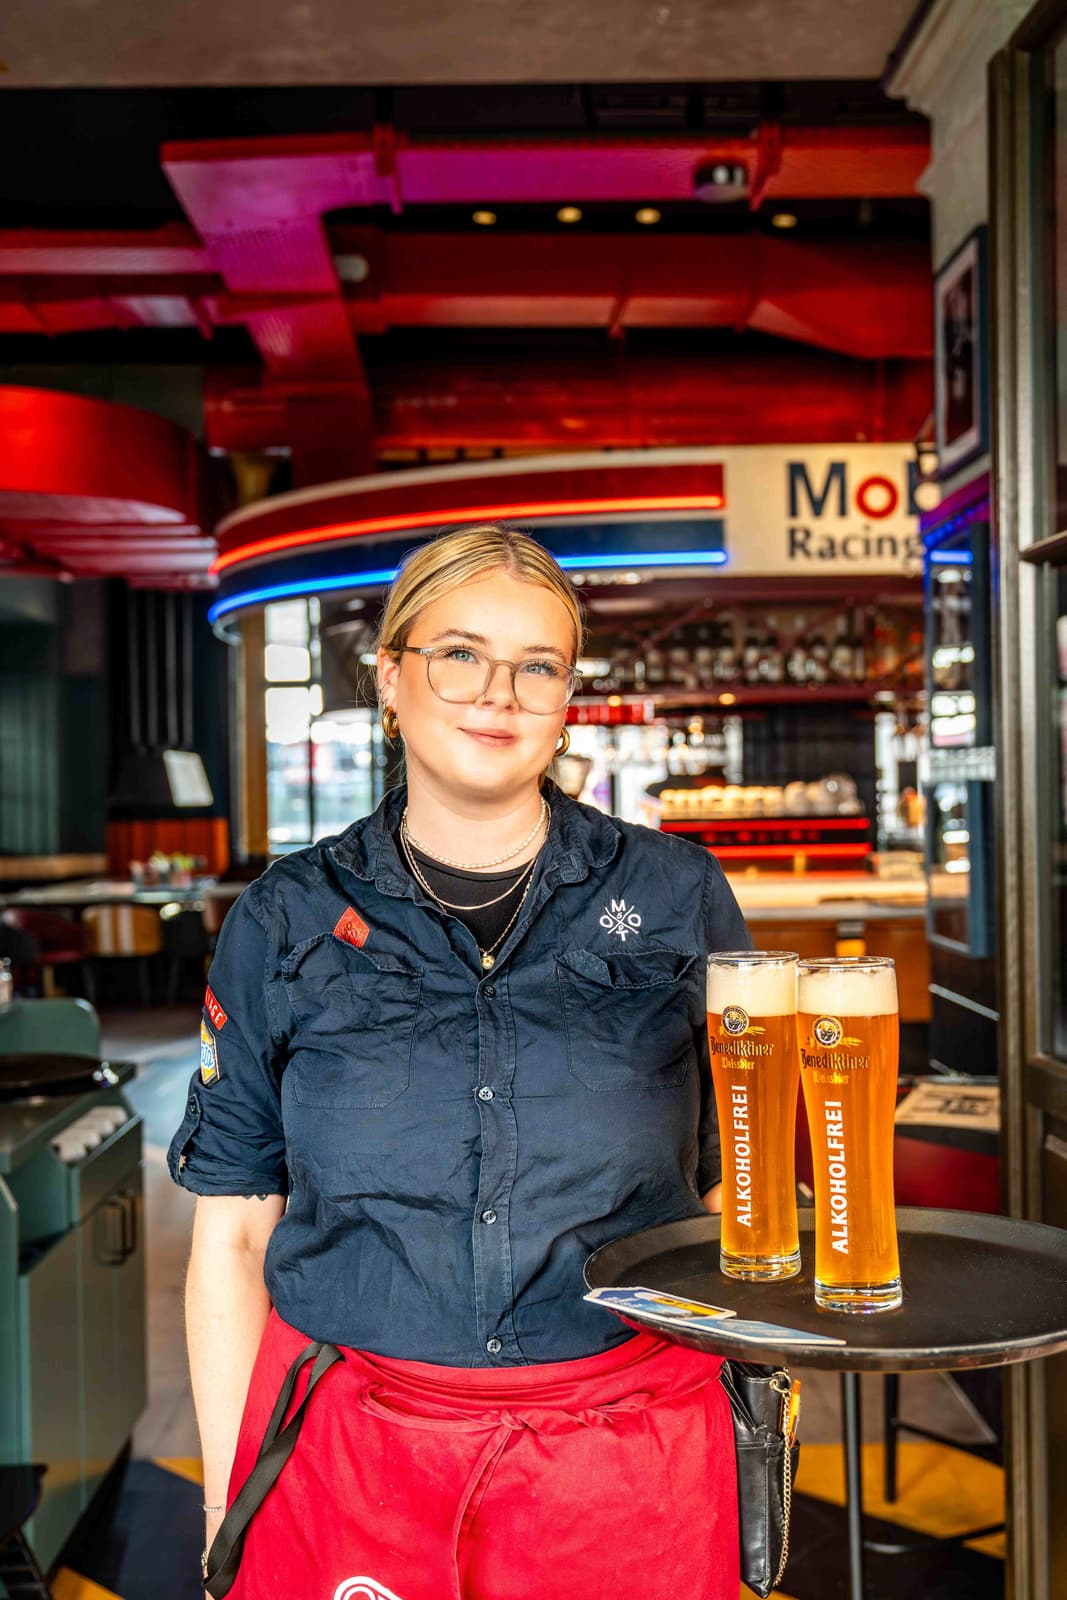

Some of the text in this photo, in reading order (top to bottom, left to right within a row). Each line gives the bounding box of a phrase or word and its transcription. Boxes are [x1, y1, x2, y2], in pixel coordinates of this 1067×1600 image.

[787, 526, 924, 570] Racing
[710, 1036, 774, 1057] Benediktiner
[800, 1048, 870, 1071] Benediktiner
[731, 1084, 752, 1228] ALKOHOLFREI
[824, 1100, 849, 1255] ALKOHOLFREI
